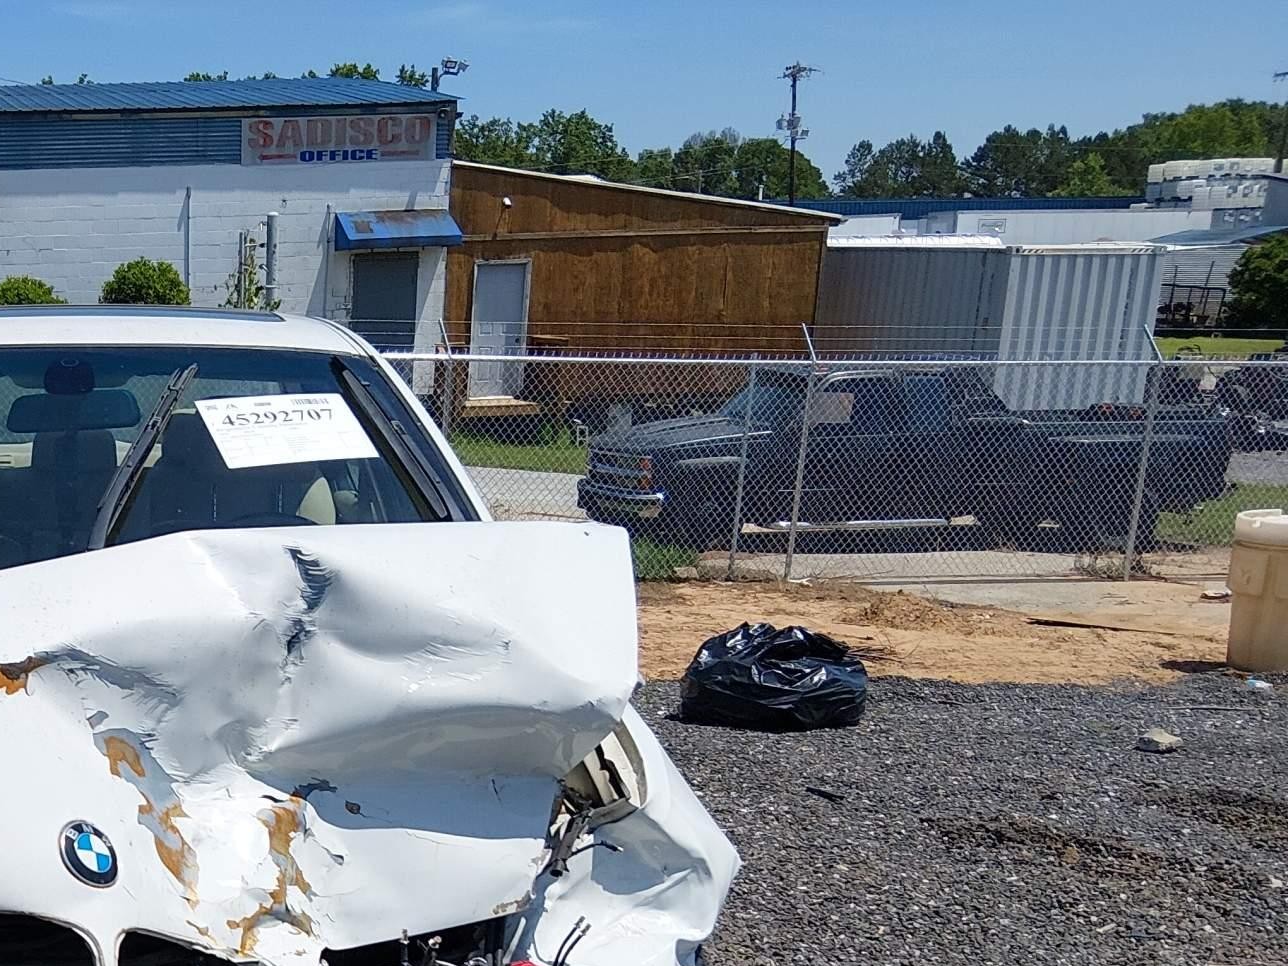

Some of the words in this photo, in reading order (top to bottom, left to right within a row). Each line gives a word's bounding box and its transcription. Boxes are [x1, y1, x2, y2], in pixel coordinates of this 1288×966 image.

[248, 116, 431, 149] SADISCO
[299, 149, 379, 162] OFFICE
[221, 408, 333, 427] 45292707
